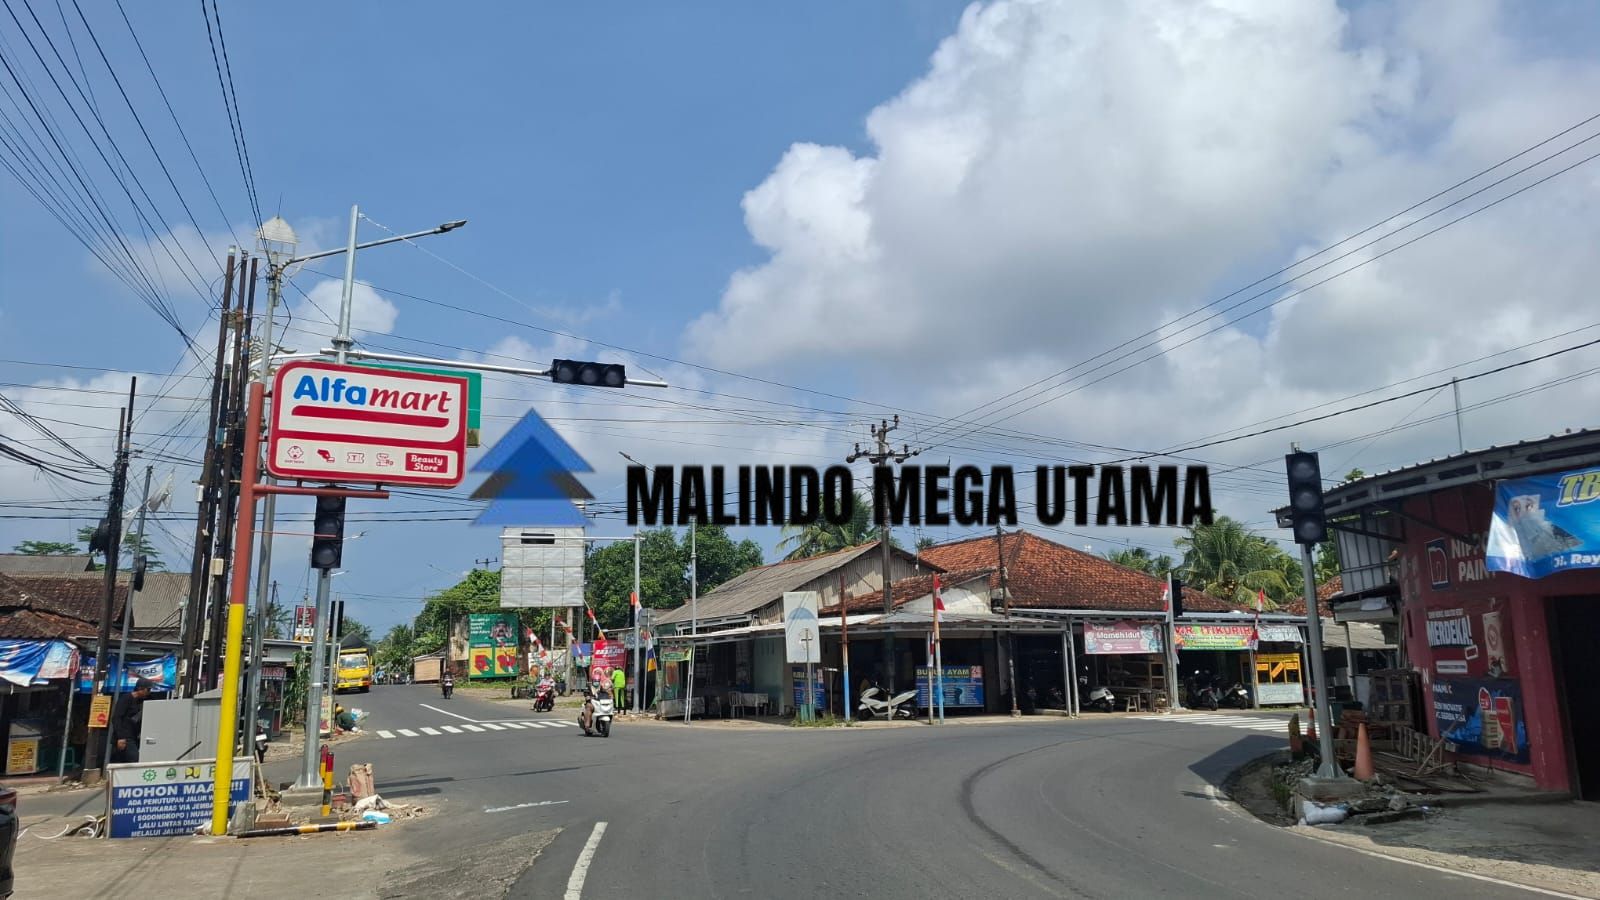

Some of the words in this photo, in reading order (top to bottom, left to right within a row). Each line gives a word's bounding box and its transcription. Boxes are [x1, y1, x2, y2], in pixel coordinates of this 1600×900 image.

[293, 375, 452, 413] Alfamart
[411, 455, 443, 466] Beauty
[413, 463, 438, 472] Store
[1426, 615, 1473, 647] MERDEKA!
[947, 668, 969, 676] AYAM
[118, 785, 178, 798] MOHON
[183, 782, 216, 794] MAA
[143, 796, 185, 805] PENUTUPAN
[136, 805, 177, 814] BATUKARAS
[179, 803, 190, 811] VIA
[137, 813, 185, 821] SODONGKOPO
[138, 821, 156, 829] LALU
[157, 820, 182, 828] LINTAS
[130, 829, 161, 837] MELALUI
[162, 827, 184, 835] JALUR
